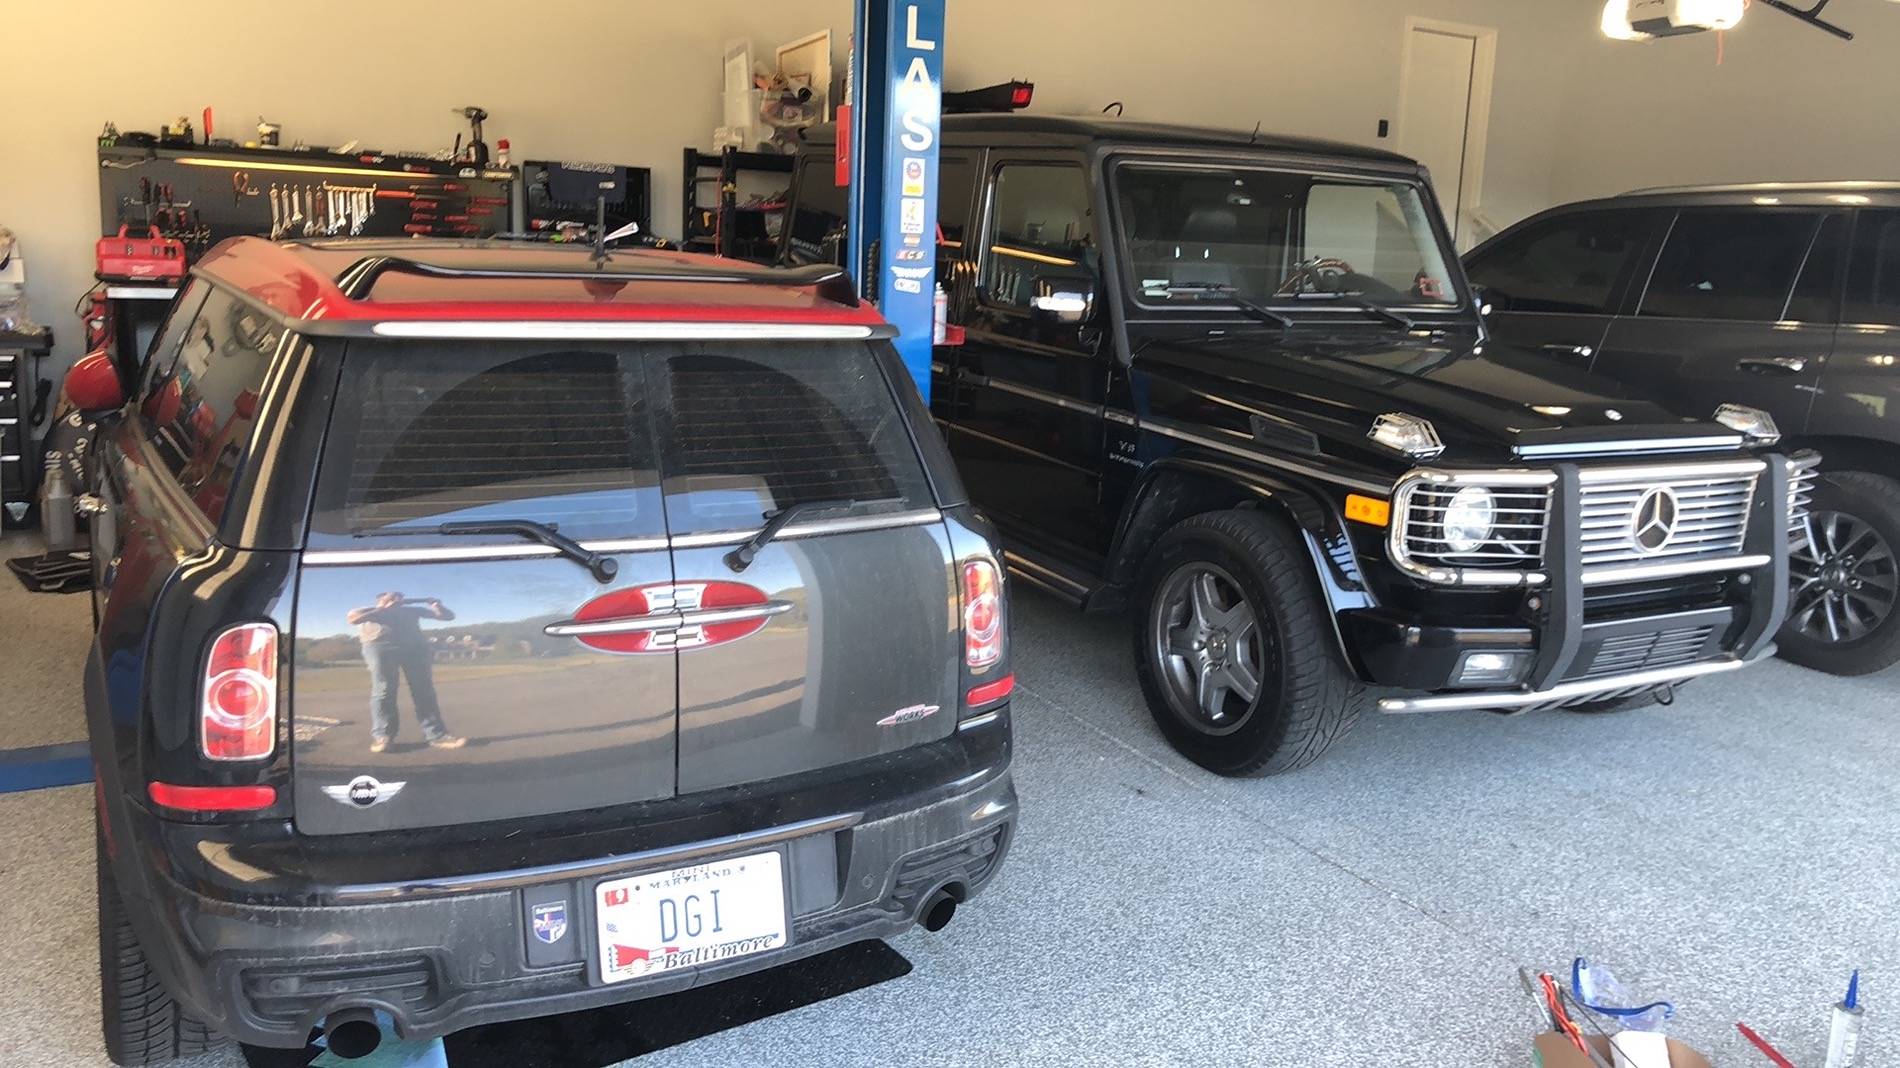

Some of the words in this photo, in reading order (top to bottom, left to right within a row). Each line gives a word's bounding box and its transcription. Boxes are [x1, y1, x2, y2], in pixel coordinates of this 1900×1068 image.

[900, 5, 936, 152] LAS
[649, 868, 732, 889] MARYLAND
[658, 889, 723, 944] DGI
[664, 935, 774, 970] Baltimore
